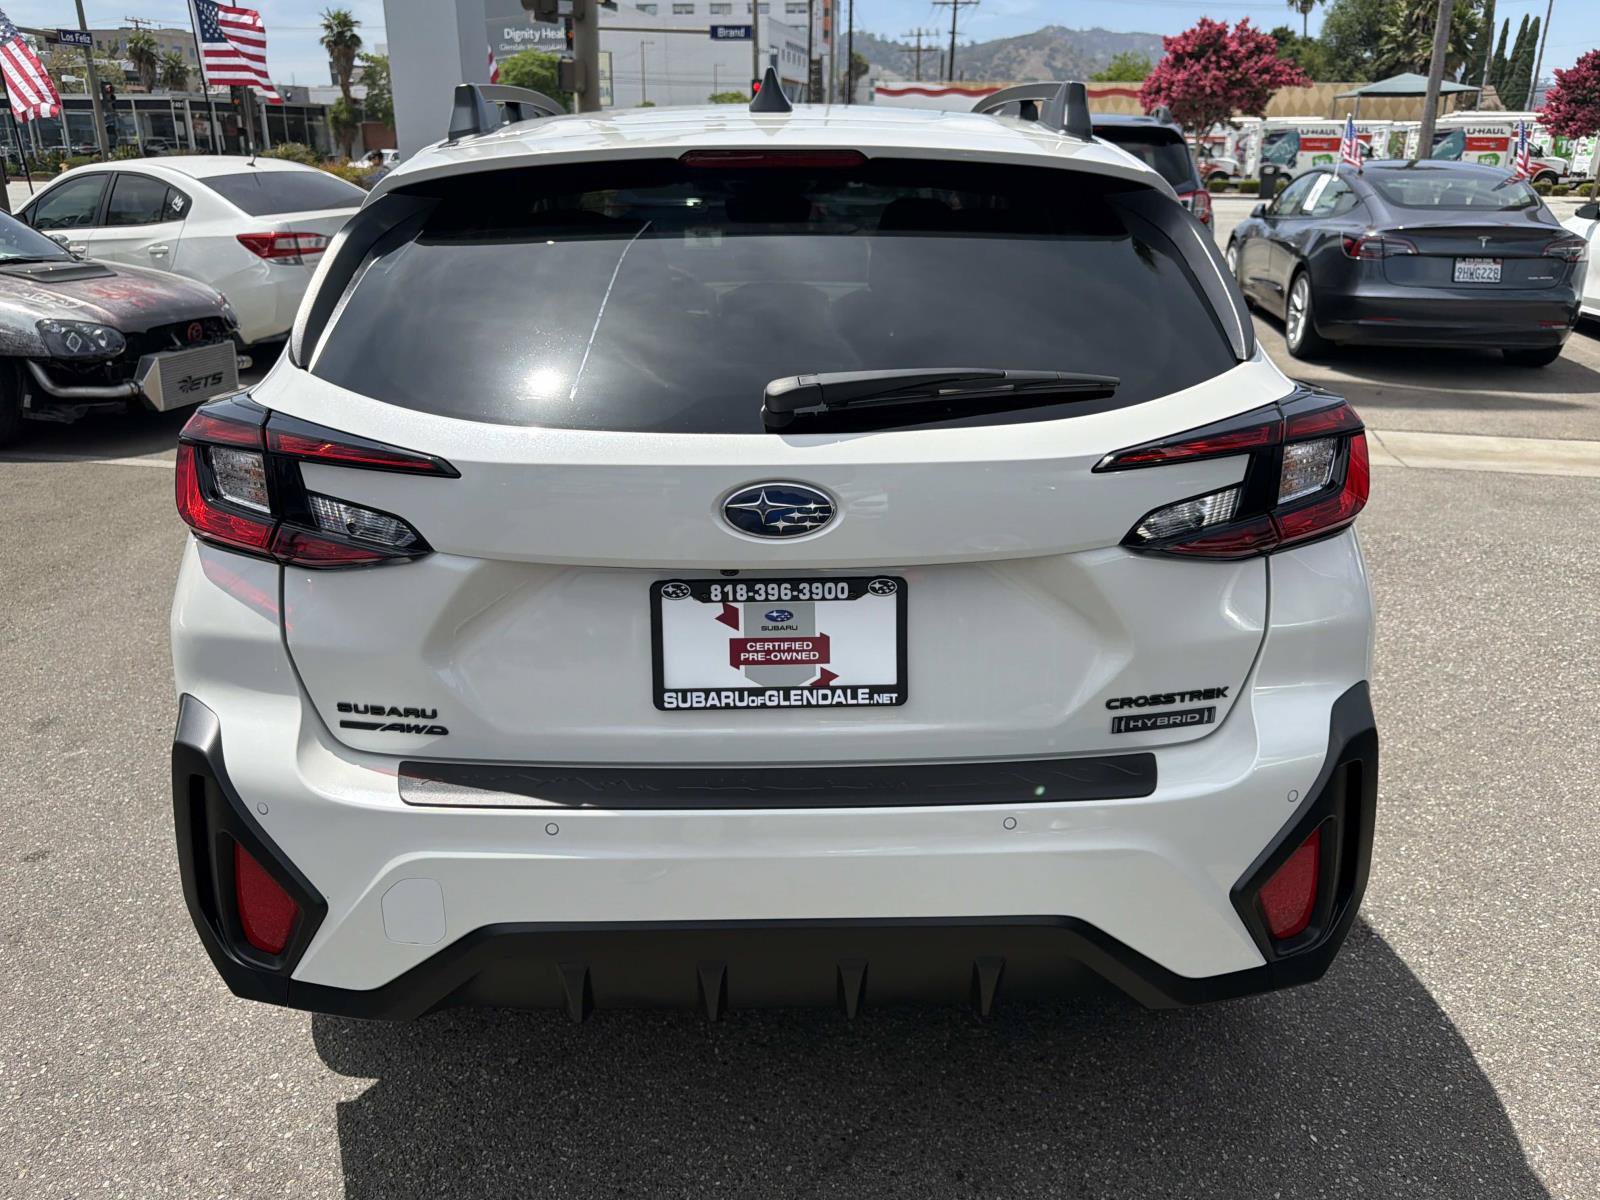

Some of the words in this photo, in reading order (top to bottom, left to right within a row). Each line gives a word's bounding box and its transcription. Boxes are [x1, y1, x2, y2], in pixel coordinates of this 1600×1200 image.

[60, 31, 75, 42] Los
[75, 33, 92, 44] Feliz
[503, 27, 541, 42] Dignity
[541, 26, 566, 39] Heal
[717, 27, 746, 38] Brand
[1466, 127, 1506, 136] U-HAUL
[189, 371, 224, 391] ETS
[710, 582, 849, 602] 818-396-3900
[760, 624, 798, 632] SUBARU
[746, 641, 813, 651] CERTIFIED
[740, 651, 819, 661] PRE-OWNED
[1105, 686, 1229, 710] CROSSTREK
[337, 702, 438, 719] SUBARU
[1129, 713, 1200, 729] HYBRID
[380, 723, 449, 736] AWD
